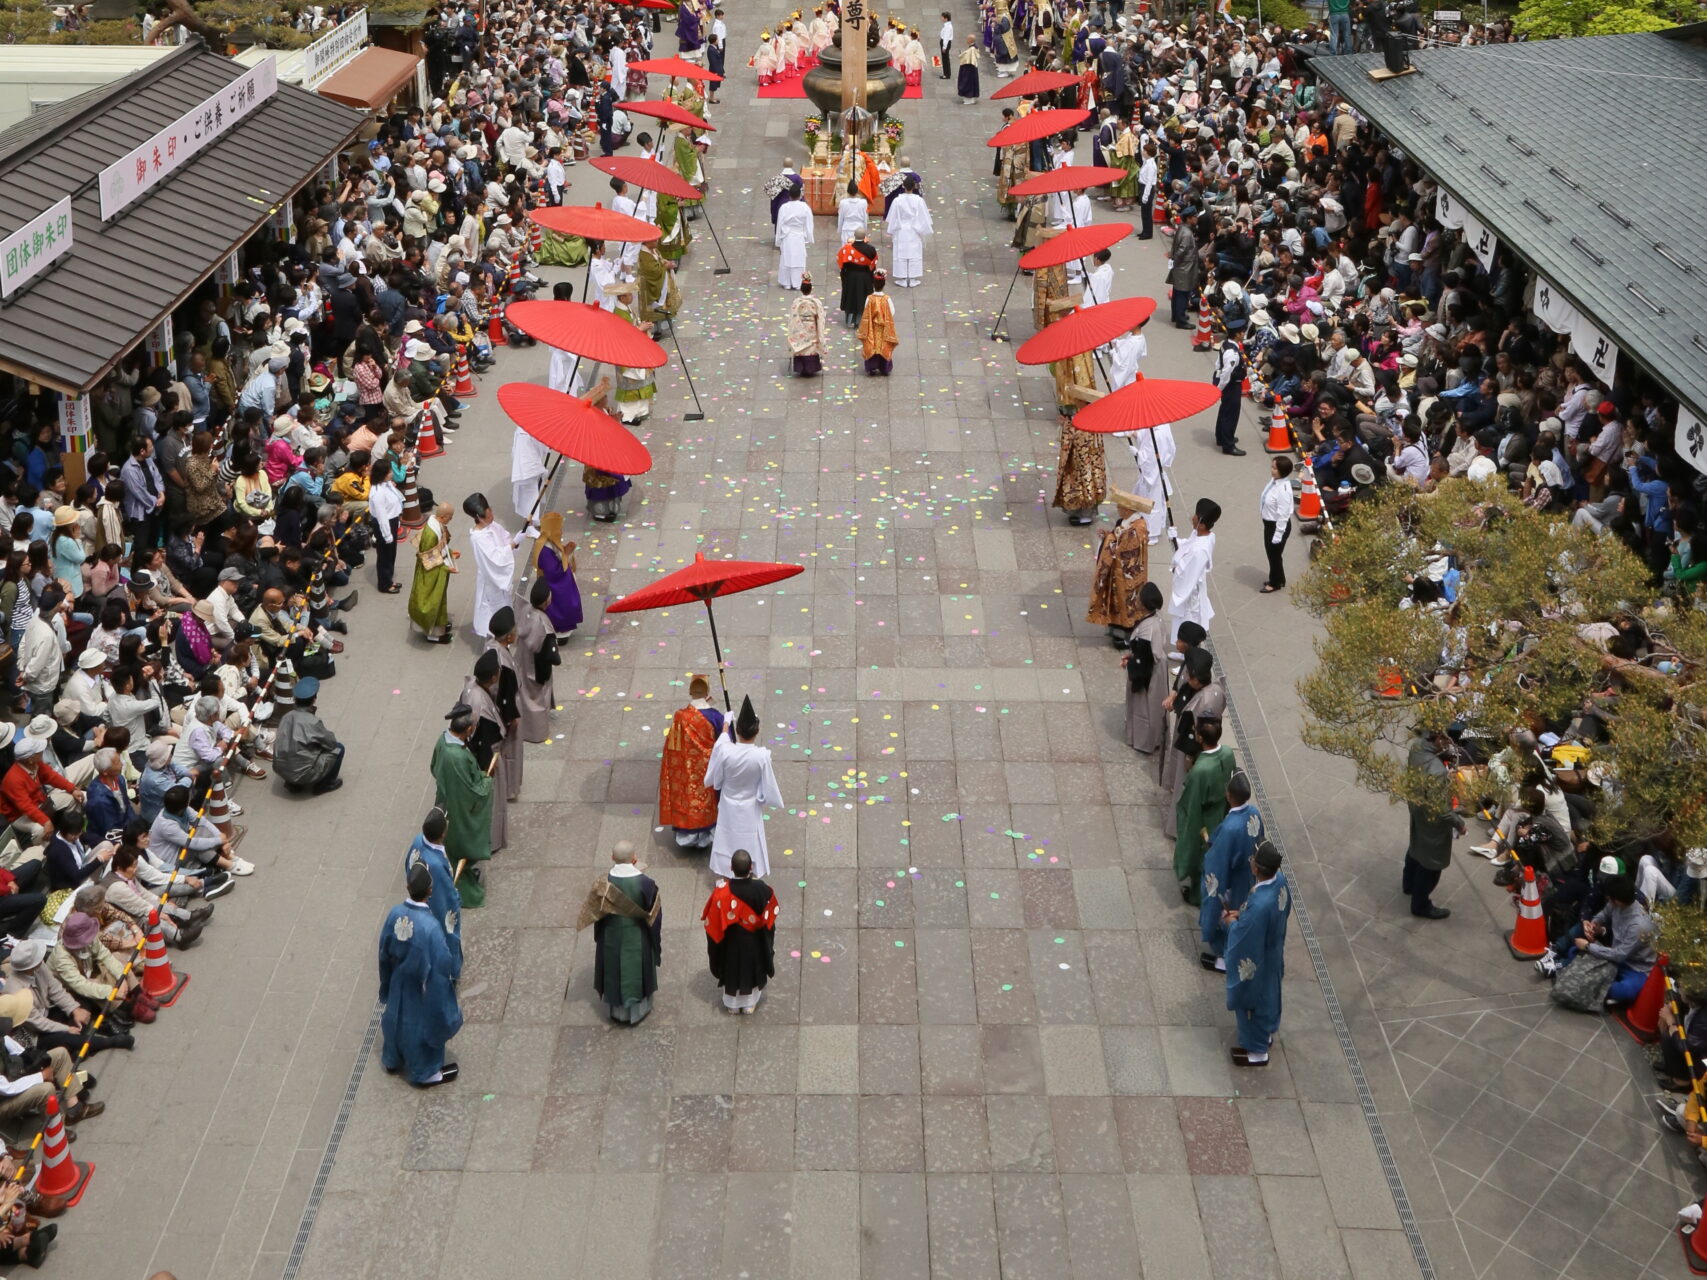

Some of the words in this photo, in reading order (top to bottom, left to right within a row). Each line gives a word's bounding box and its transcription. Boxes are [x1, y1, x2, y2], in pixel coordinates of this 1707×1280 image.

[136, 100, 223, 185] 御朱印・ご供養
[6, 214, 67, 279] 団体御朱印
